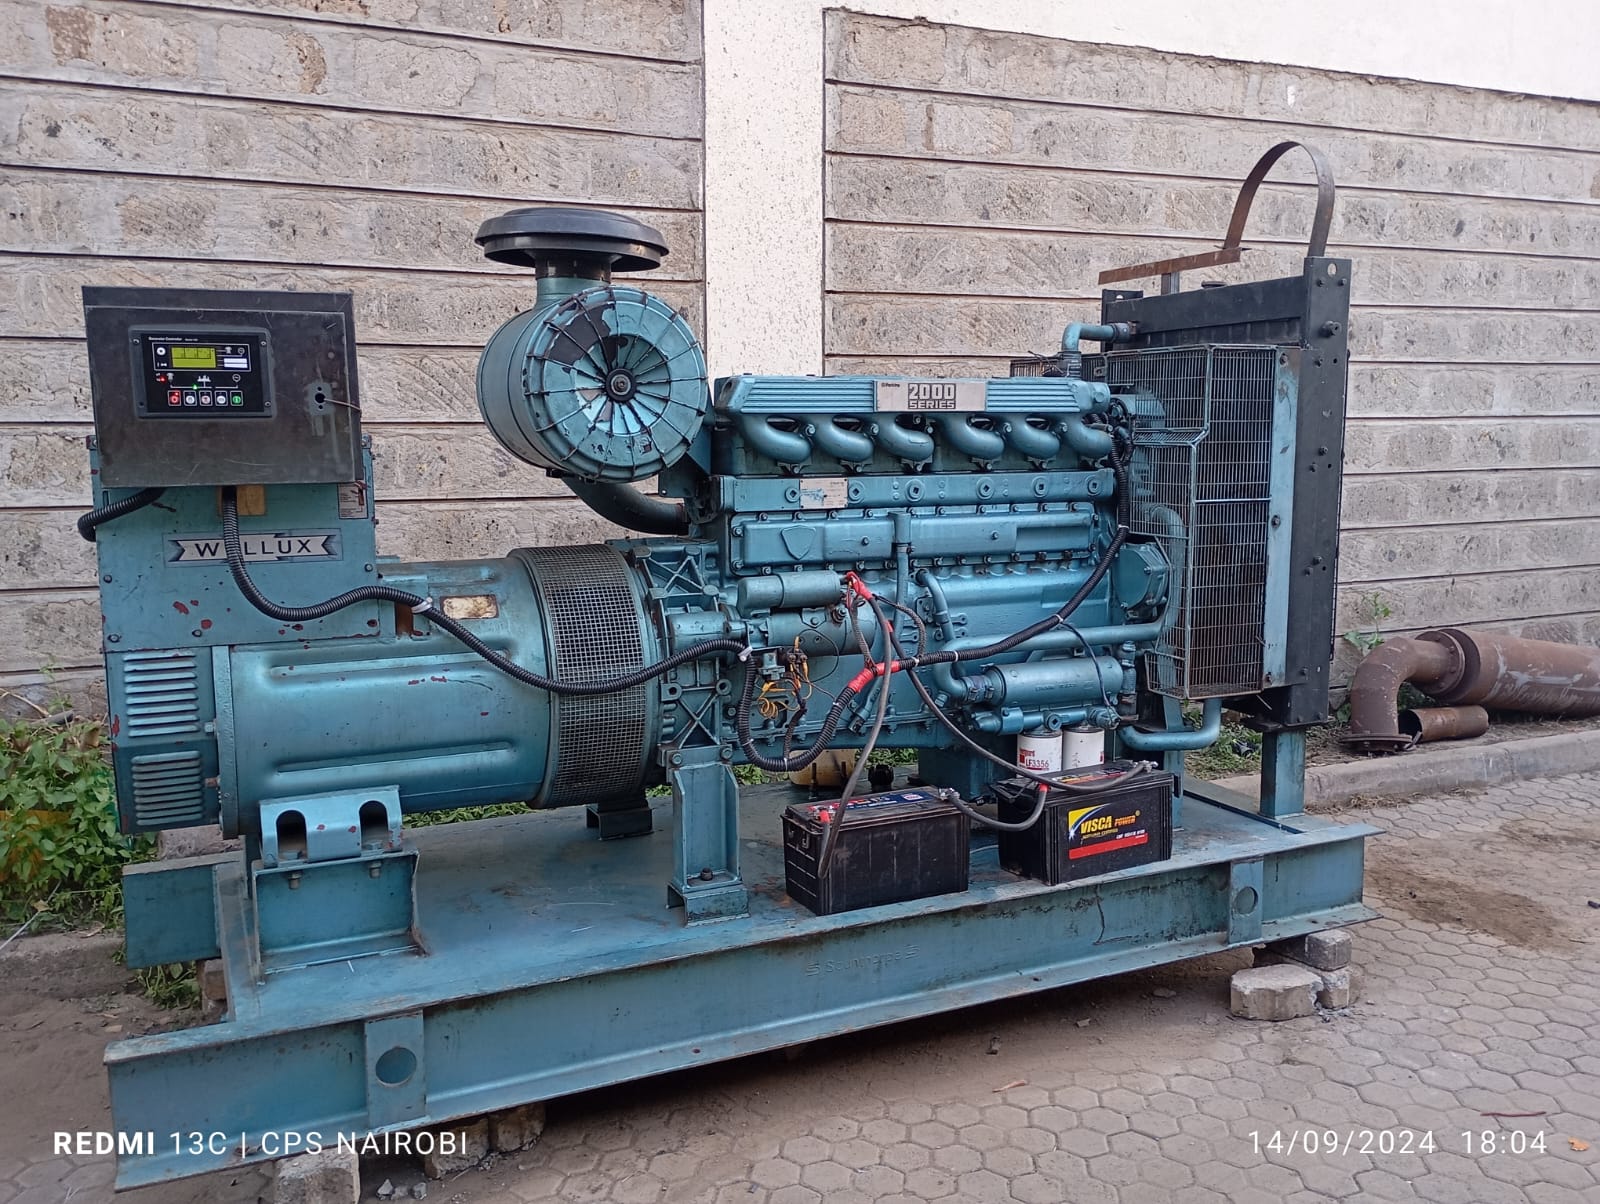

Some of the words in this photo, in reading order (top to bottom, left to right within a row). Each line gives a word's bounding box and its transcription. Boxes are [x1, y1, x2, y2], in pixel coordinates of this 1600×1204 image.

[908, 383, 956, 400] 2000
[908, 400, 956, 409] SERIES
[195, 539, 312, 557] WLLUX
[1026, 759, 1049, 768] LF3356
[1081, 816, 1112, 834] VISCA
